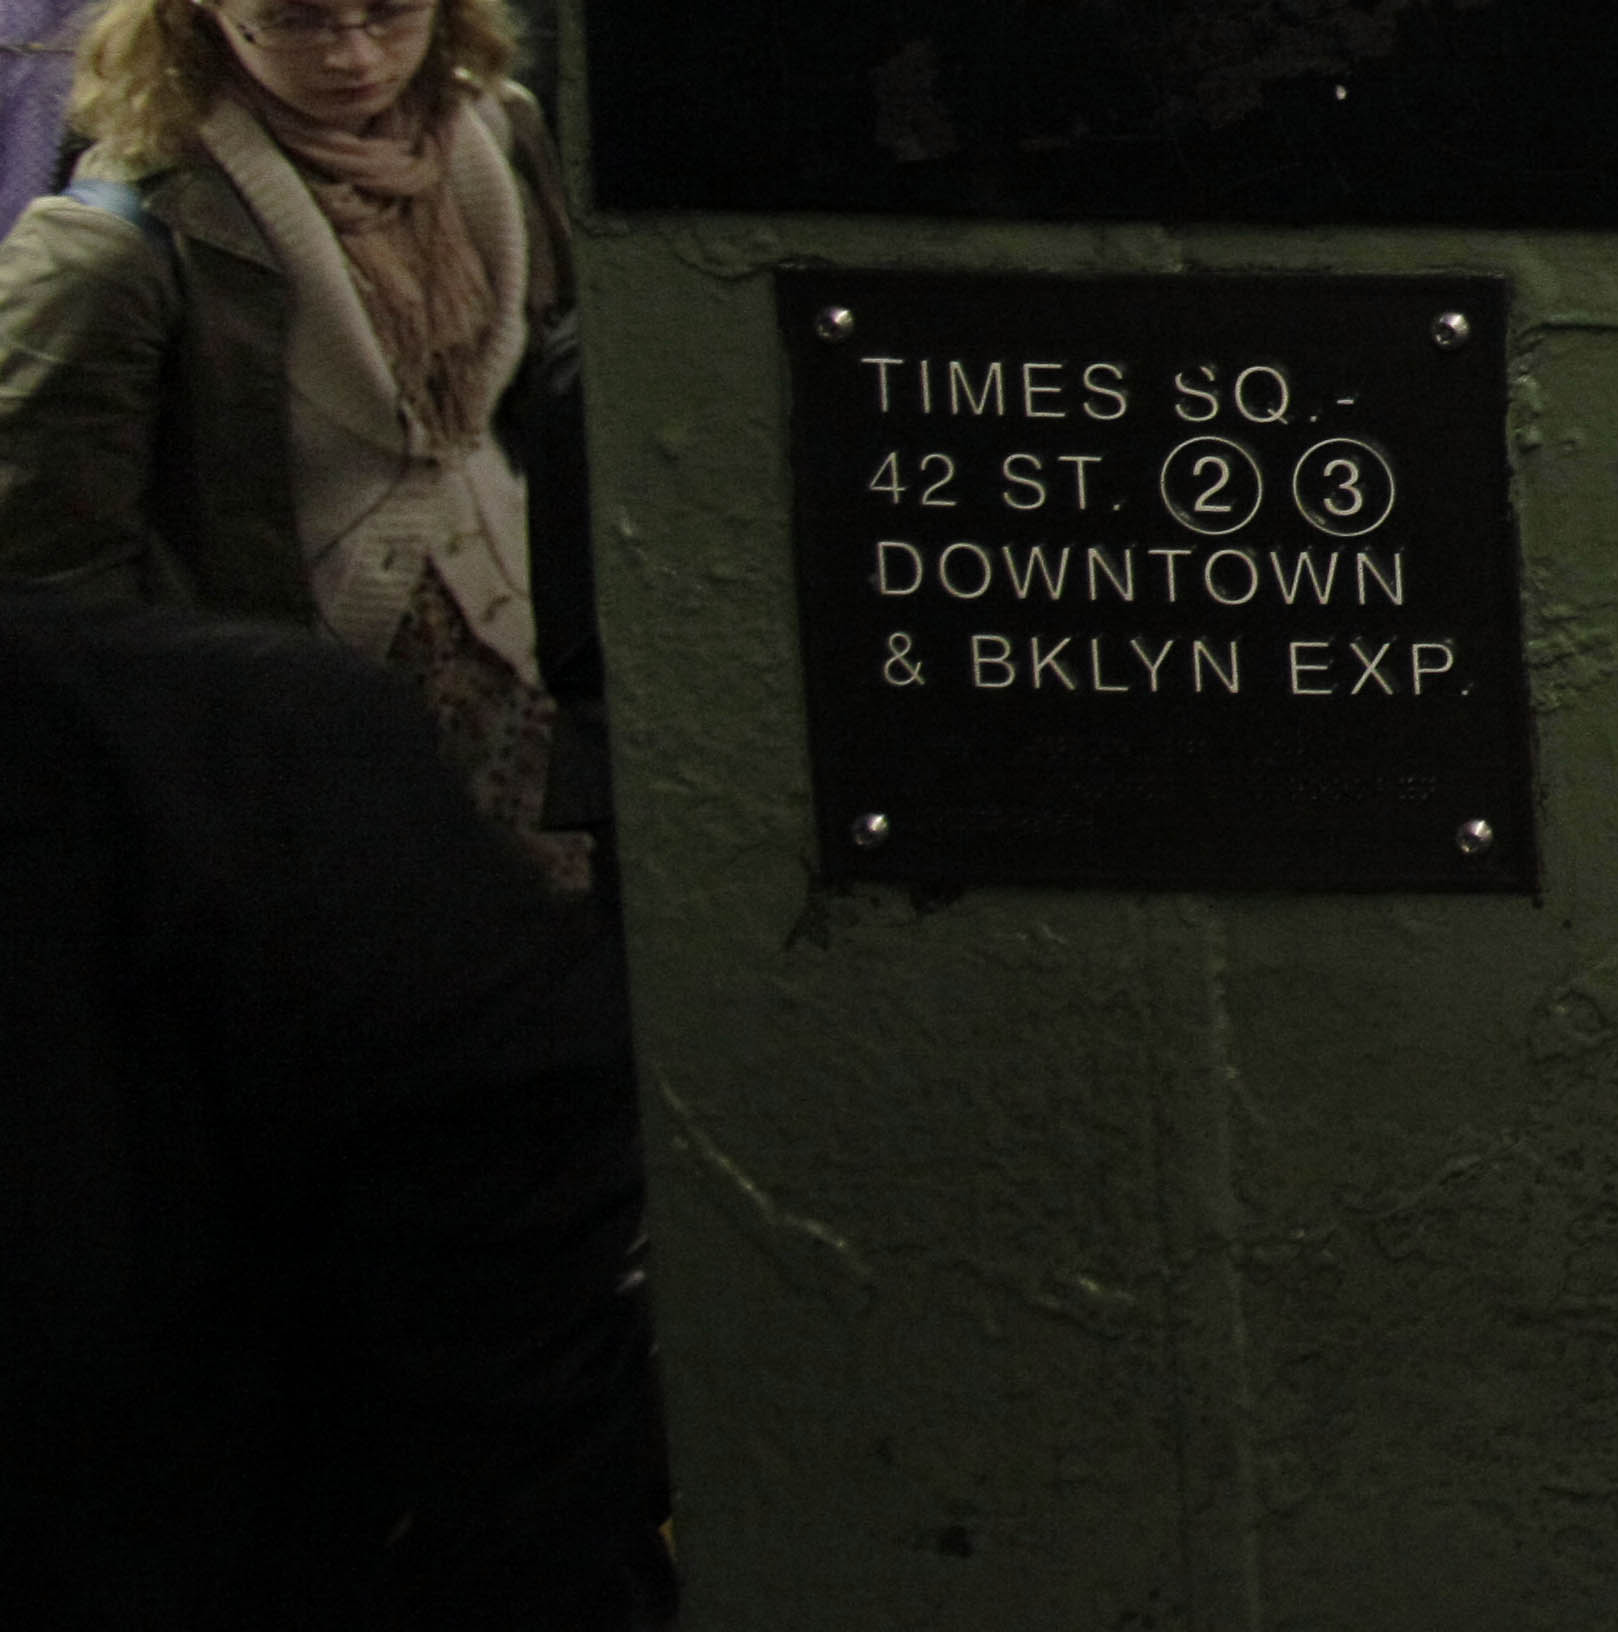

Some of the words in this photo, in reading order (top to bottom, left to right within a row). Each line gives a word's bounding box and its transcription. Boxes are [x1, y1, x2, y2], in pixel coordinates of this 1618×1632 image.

[860, 357, 1128, 420] TIMES
[868, 450, 958, 508] 42
[1002, 453, 1125, 511] ST.
[875, 540, 1404, 606] DOWNTOWN
[883, 631, 927, 687] &
[970, 633, 1241, 693] BKLYN
[1289, 640, 1471, 697] EXP.
